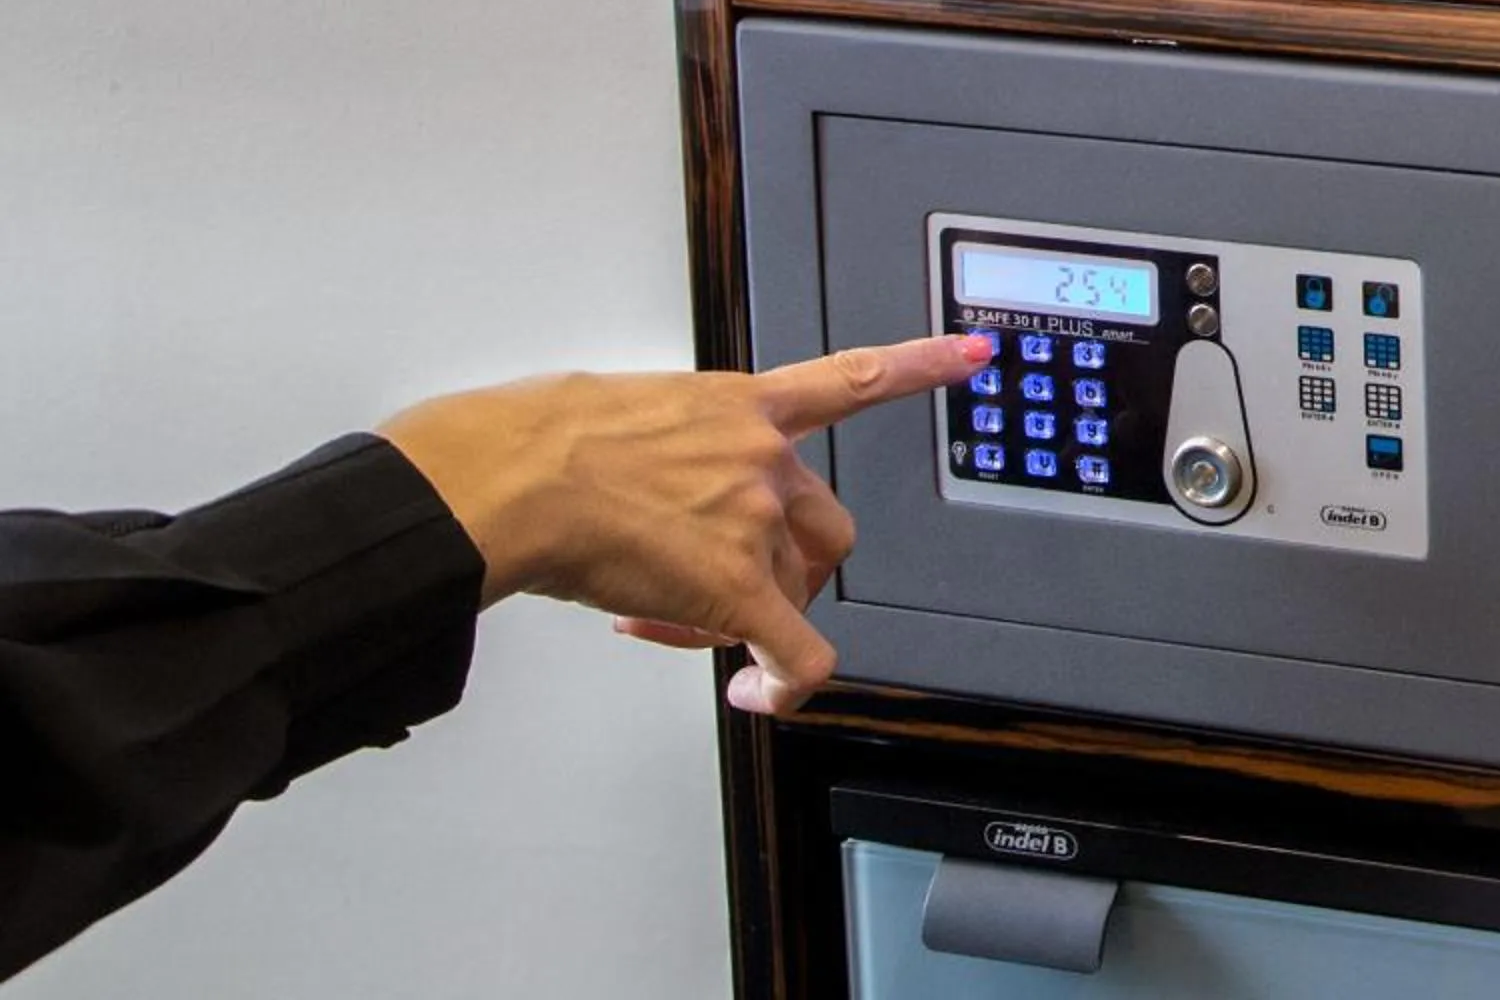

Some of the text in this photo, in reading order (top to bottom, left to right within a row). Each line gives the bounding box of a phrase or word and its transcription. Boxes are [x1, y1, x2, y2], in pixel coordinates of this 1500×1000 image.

[1055, 266, 1128, 306] 254
[977, 309, 1011, 324] SAFE
[1013, 313, 1029, 328] 30
[1047, 317, 1094, 338] PLUS
[993, 828, 1051, 852] indel
[1053, 836, 1067, 854] B
